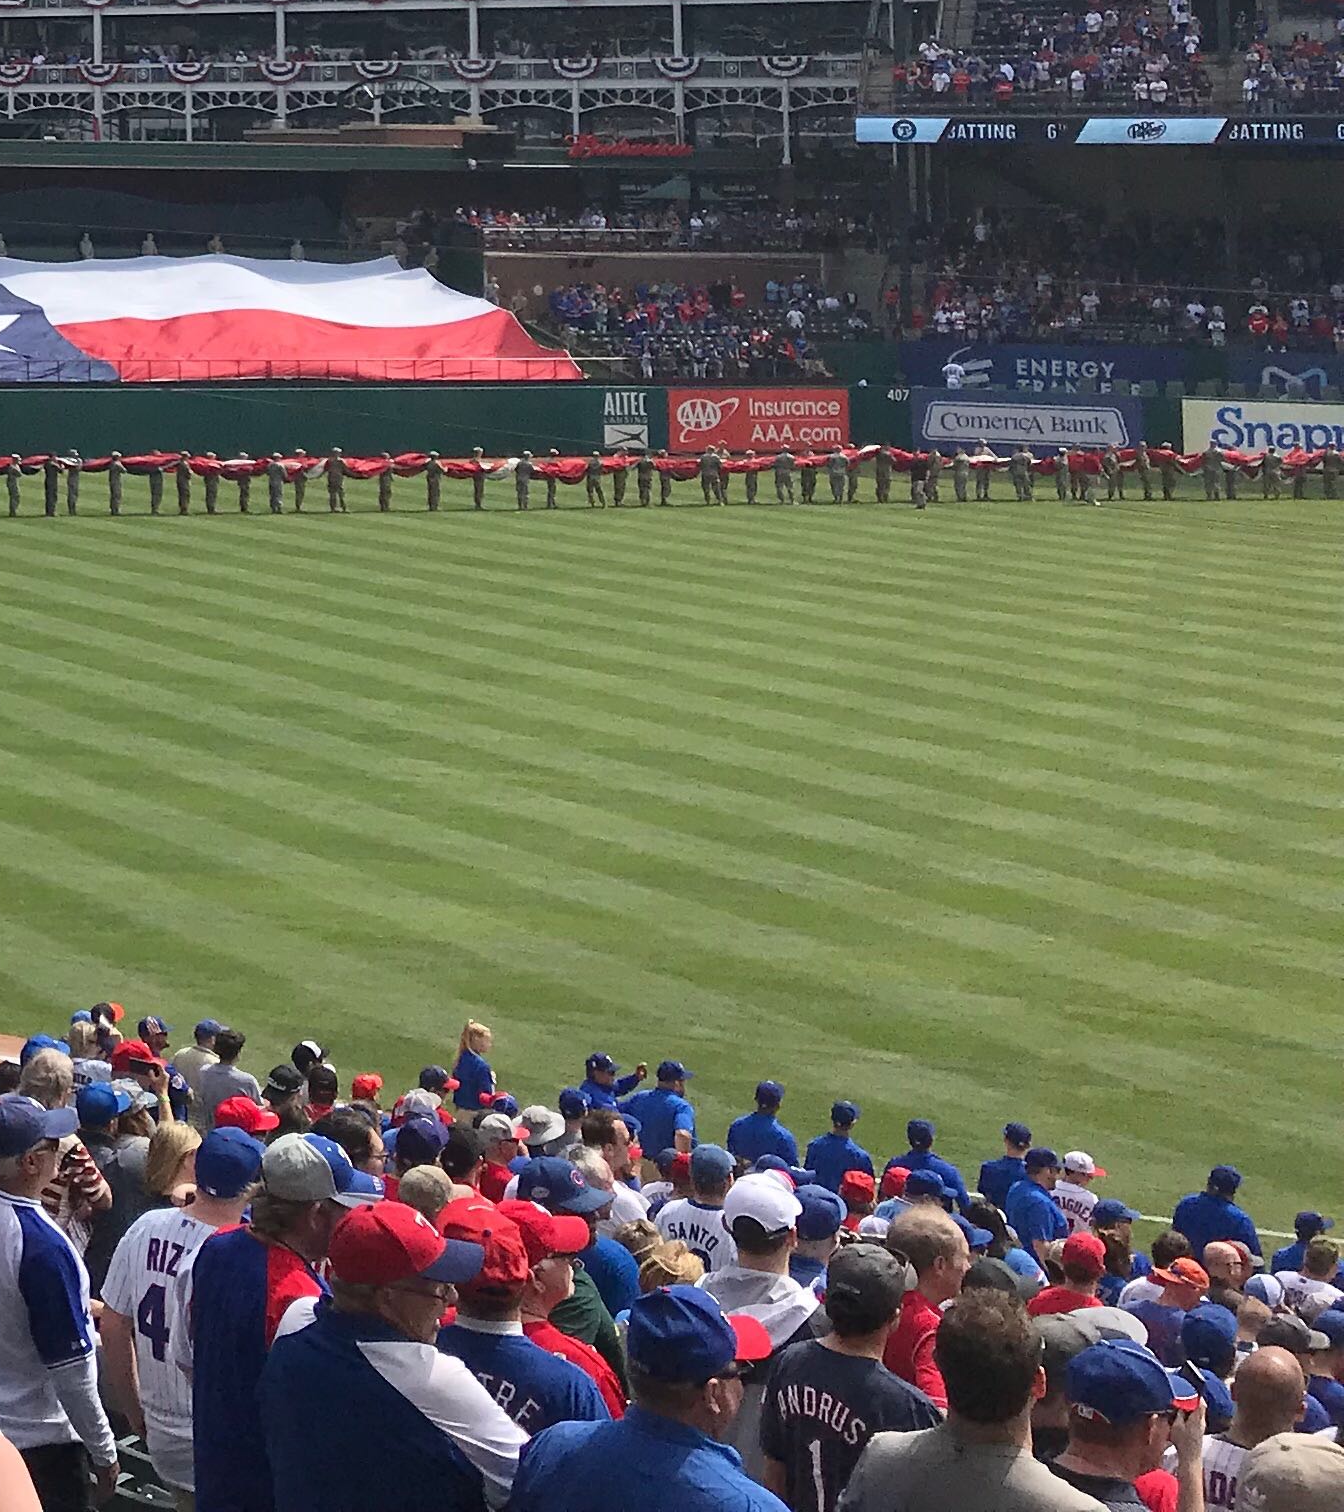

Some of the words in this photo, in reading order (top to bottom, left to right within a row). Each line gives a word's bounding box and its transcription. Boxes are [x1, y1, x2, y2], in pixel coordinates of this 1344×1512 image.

[1016, 358, 1115, 379] ENERGY
[603, 391, 649, 417] ALTEC
[886, 388, 910, 402] 407
[680, 402, 722, 429] AAA
[748, 397, 841, 418] Insurance
[750, 424, 842, 443] AAA.com
[1050, 415, 1109, 435] Bank
[667, 1221, 720, 1253] SANTO
[777, 1383, 868, 1446] ANDRUS
